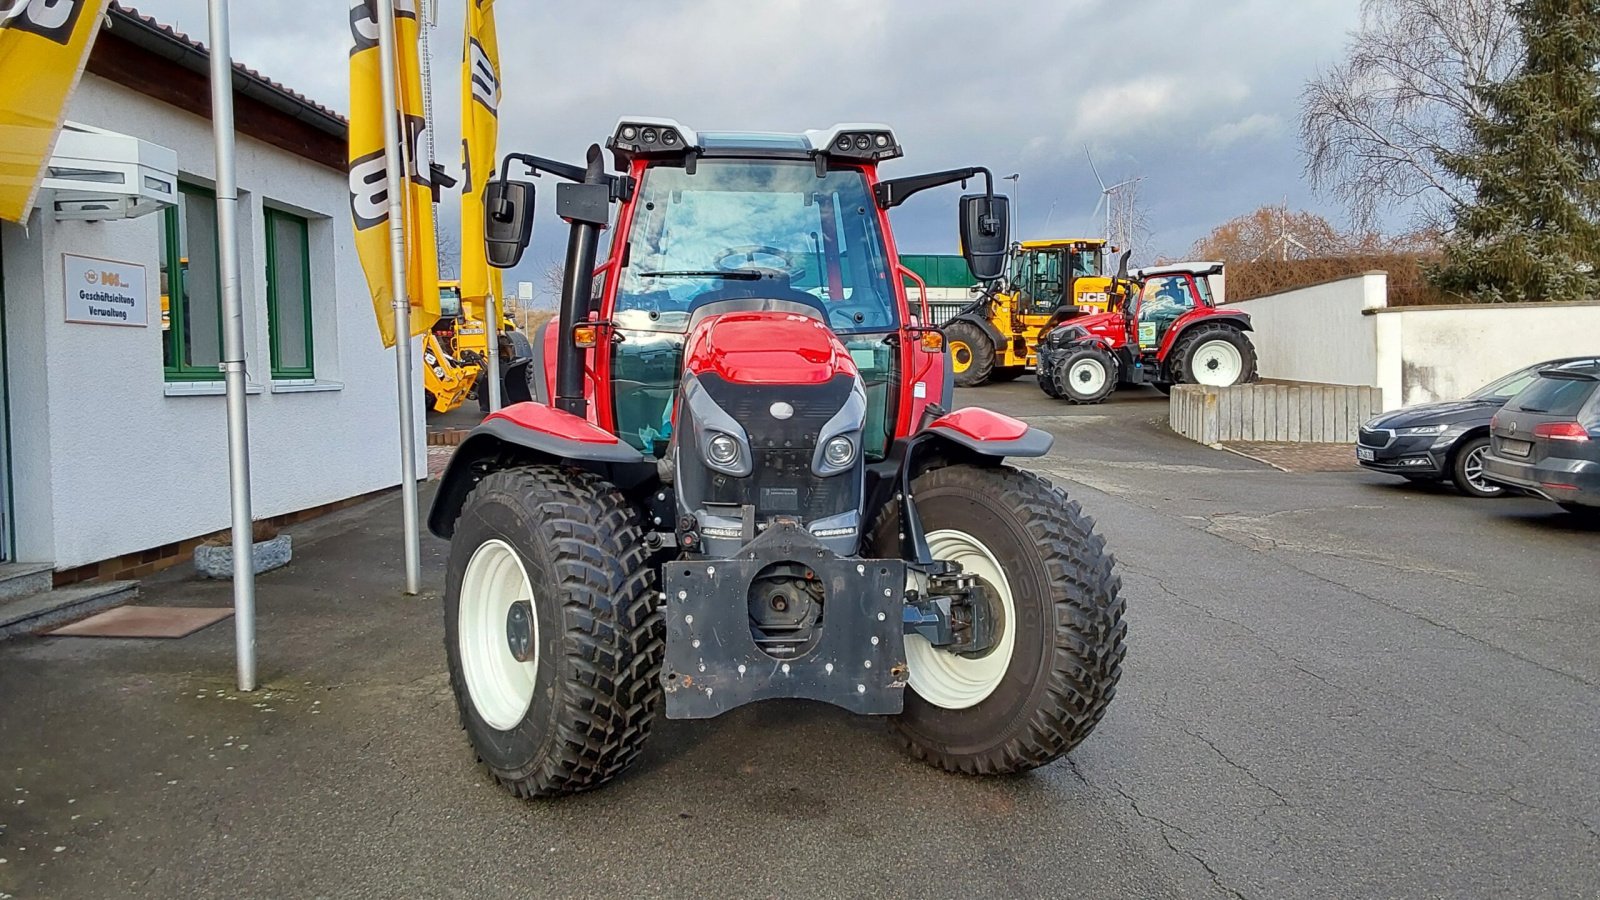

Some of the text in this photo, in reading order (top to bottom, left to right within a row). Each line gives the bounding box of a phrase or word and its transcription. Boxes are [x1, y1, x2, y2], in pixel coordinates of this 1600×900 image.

[80, 290, 135, 307] Geschäftsleitung
[1078, 292, 1107, 302] JCB
[89, 306, 127, 320] Verwaltung
